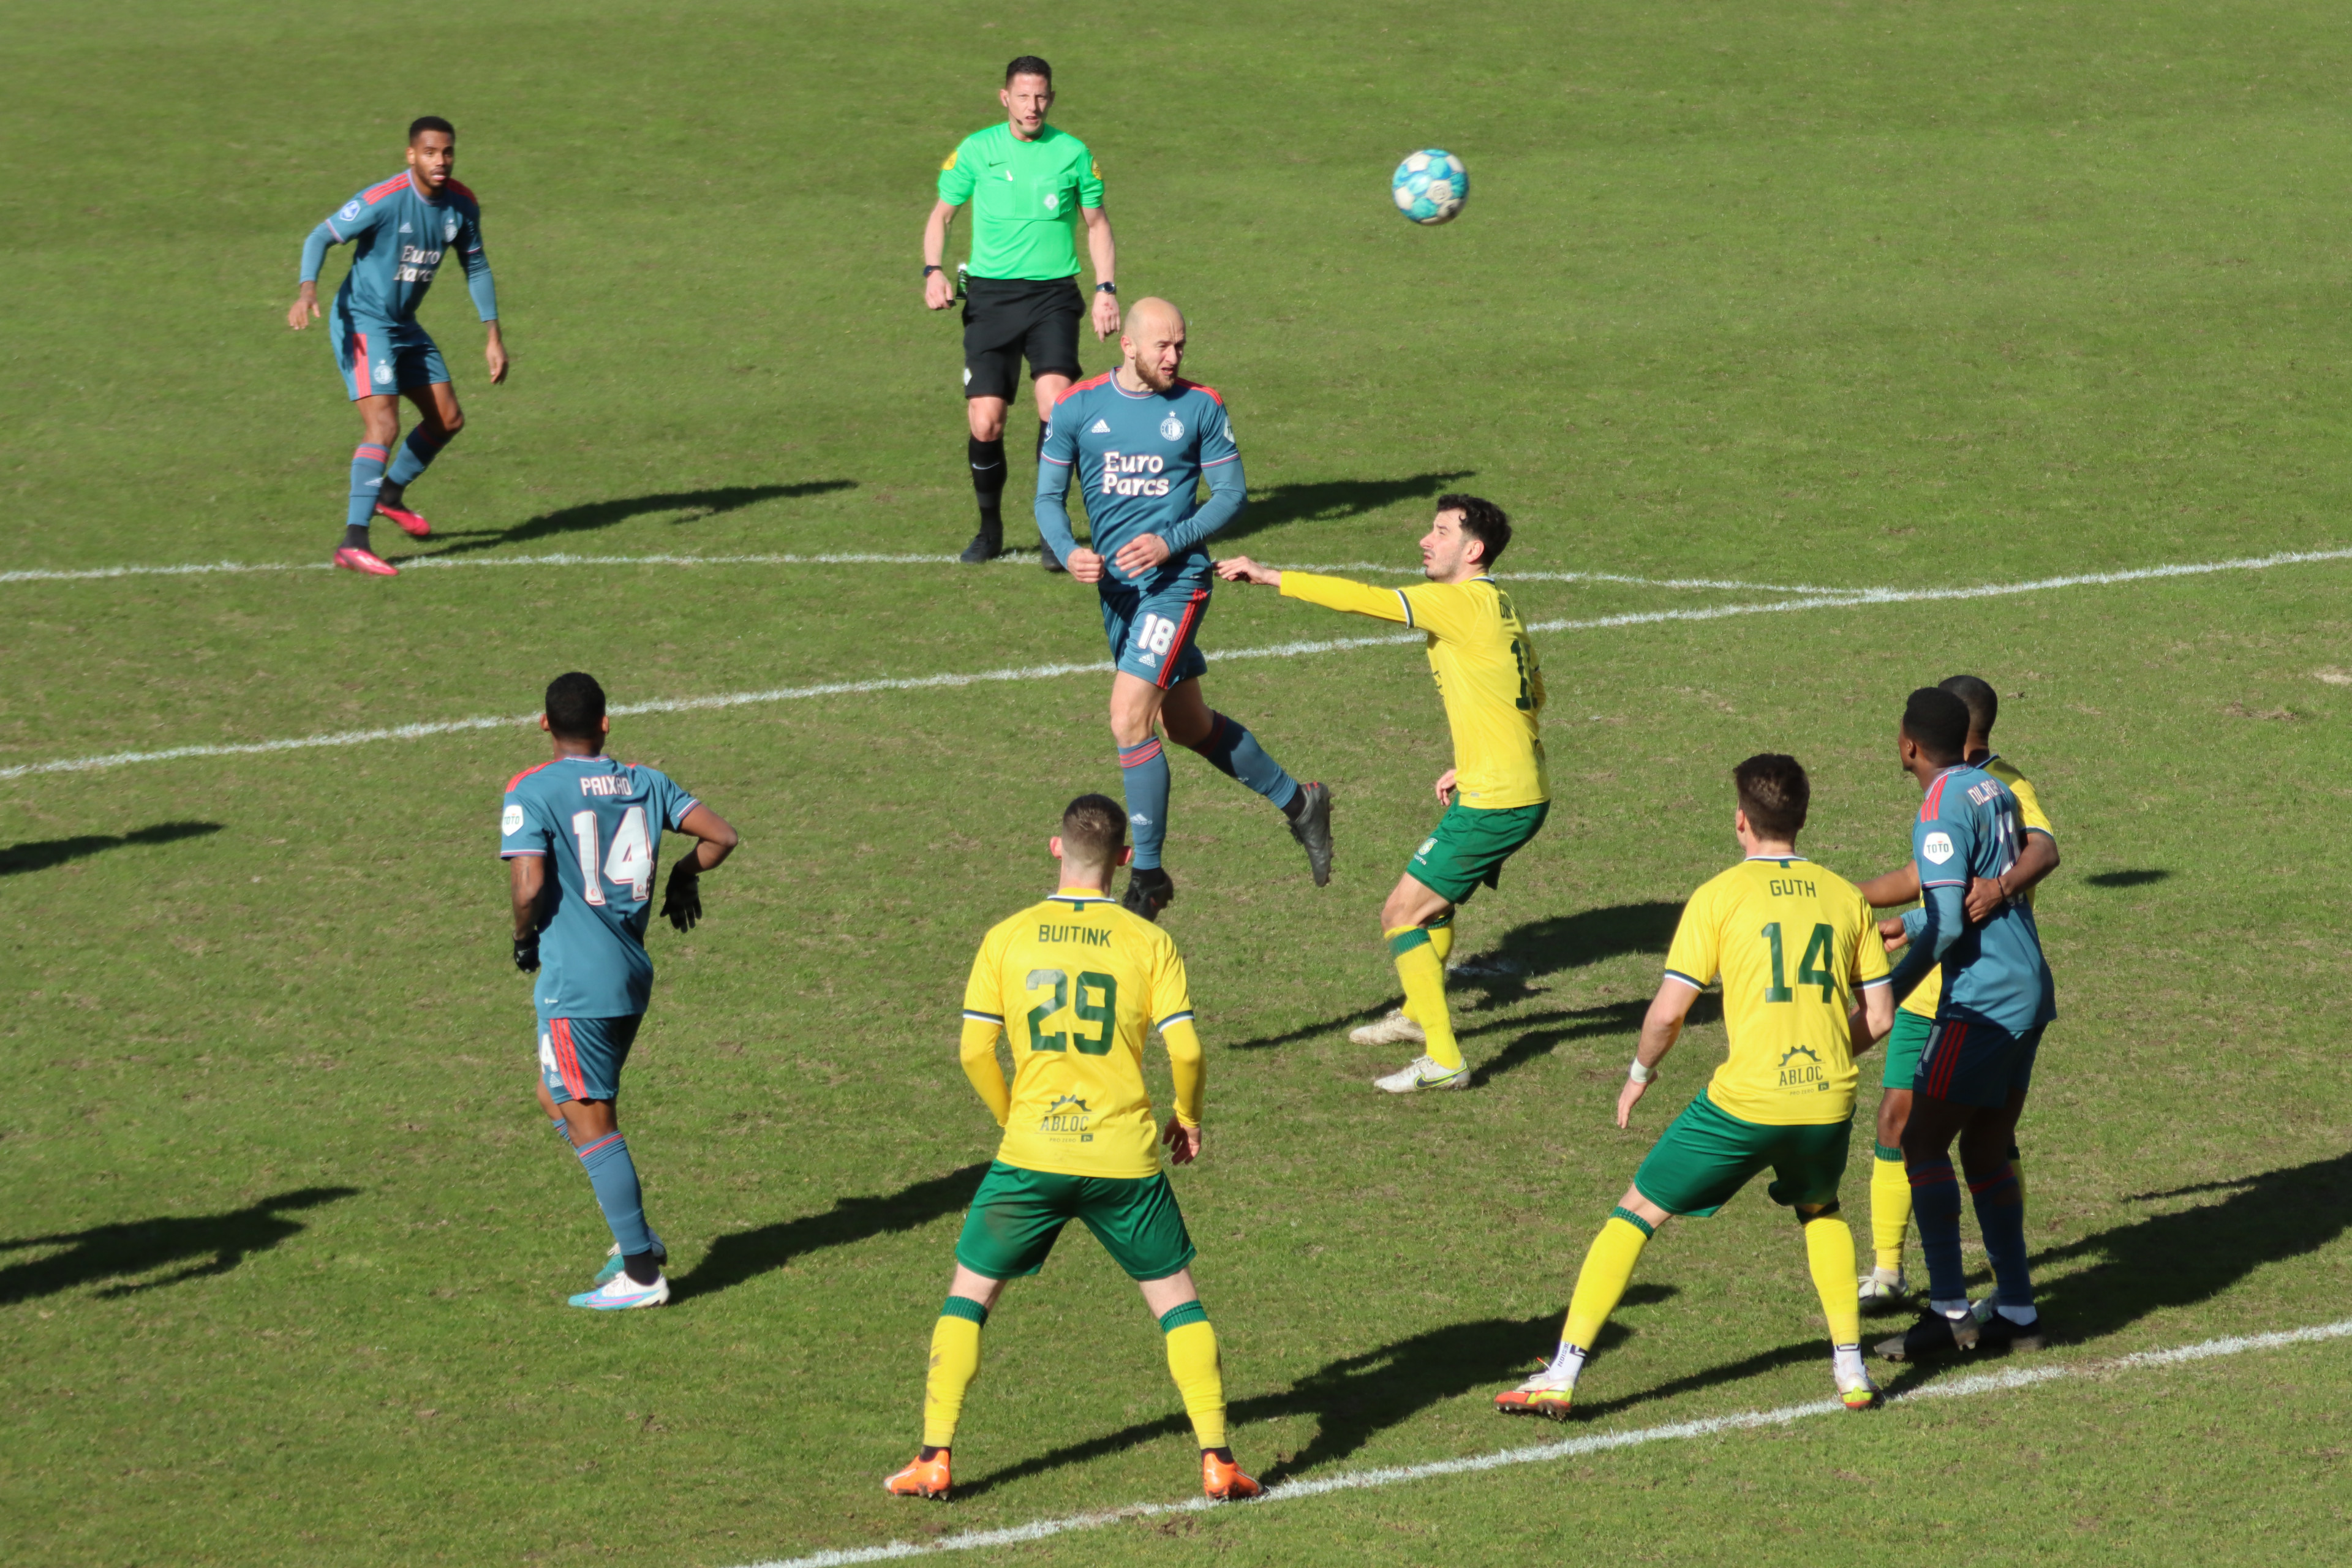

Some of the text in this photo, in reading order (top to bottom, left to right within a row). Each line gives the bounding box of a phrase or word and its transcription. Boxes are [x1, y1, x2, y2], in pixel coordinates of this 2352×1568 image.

[401, 245, 442, 265] Euro
[1104, 451, 1164, 473] Euro
[1102, 473, 1169, 496] Parcs
[1138, 614, 1176, 656] 18
[573, 806, 654, 905] 14
[1926, 843, 1949, 854] TOTO
[1770, 879, 1817, 898] GUTH
[1038, 924, 1113, 948] BUITINK
[1761, 921, 1836, 1005] 14
[1026, 969, 1118, 1057] 29
[1779, 1065, 1823, 1087] ABLOC
[1039, 1115, 1089, 1132] ABLOC
